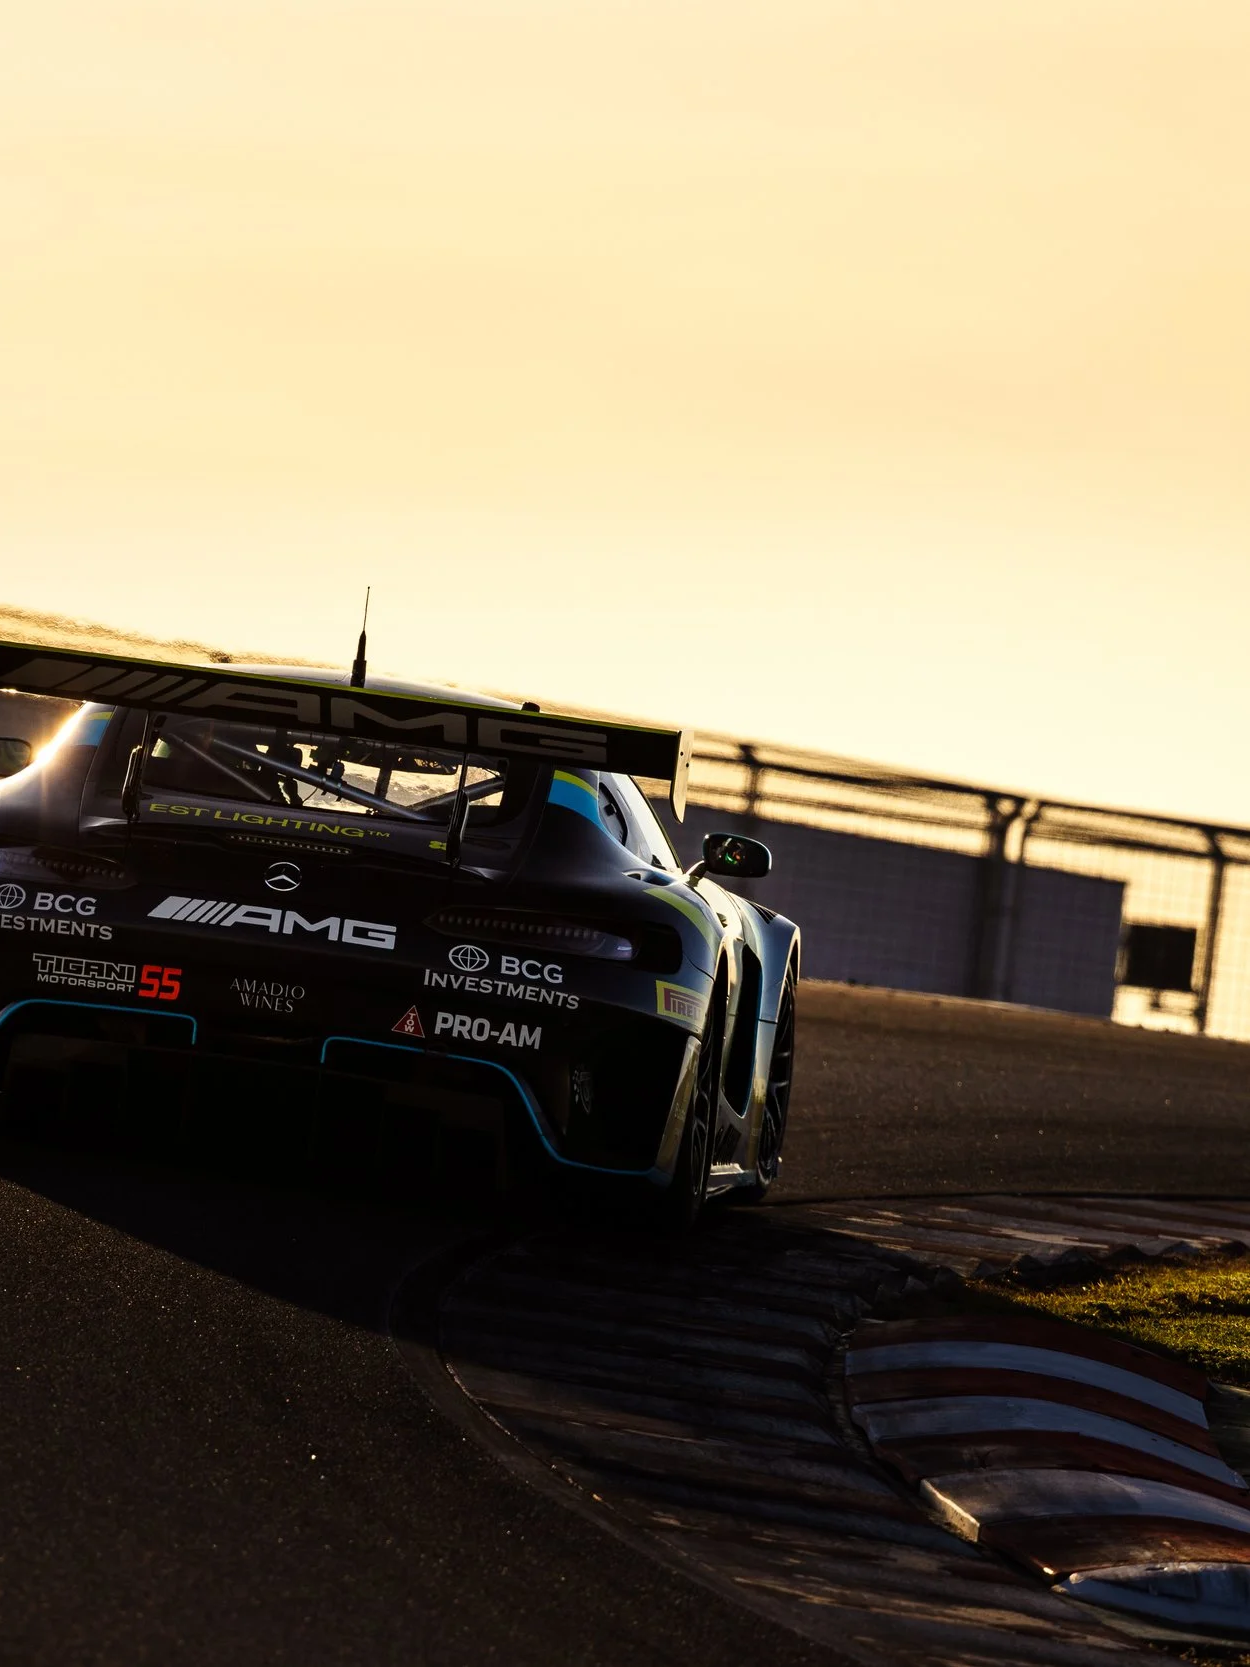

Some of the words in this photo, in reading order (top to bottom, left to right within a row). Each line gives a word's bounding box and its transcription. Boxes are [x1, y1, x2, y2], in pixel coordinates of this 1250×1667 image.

[178, 682, 608, 764] AMG
[149, 803, 210, 817] EST
[33, 892, 98, 916] BCG
[222, 904, 398, 950] AMG
[32, 952, 137, 983] TIGANI
[137, 964, 184, 1000] 55
[500, 955, 564, 984] BCG
[36, 973, 135, 993] MOTORSPORT
[229, 977, 306, 1000] AMADIO
[423, 968, 580, 1010] INVESTMENTS
[240, 992, 295, 1013] WINES
[404, 1012, 416, 1033] TOW
[433, 1011, 543, 1050] PRO-AM
